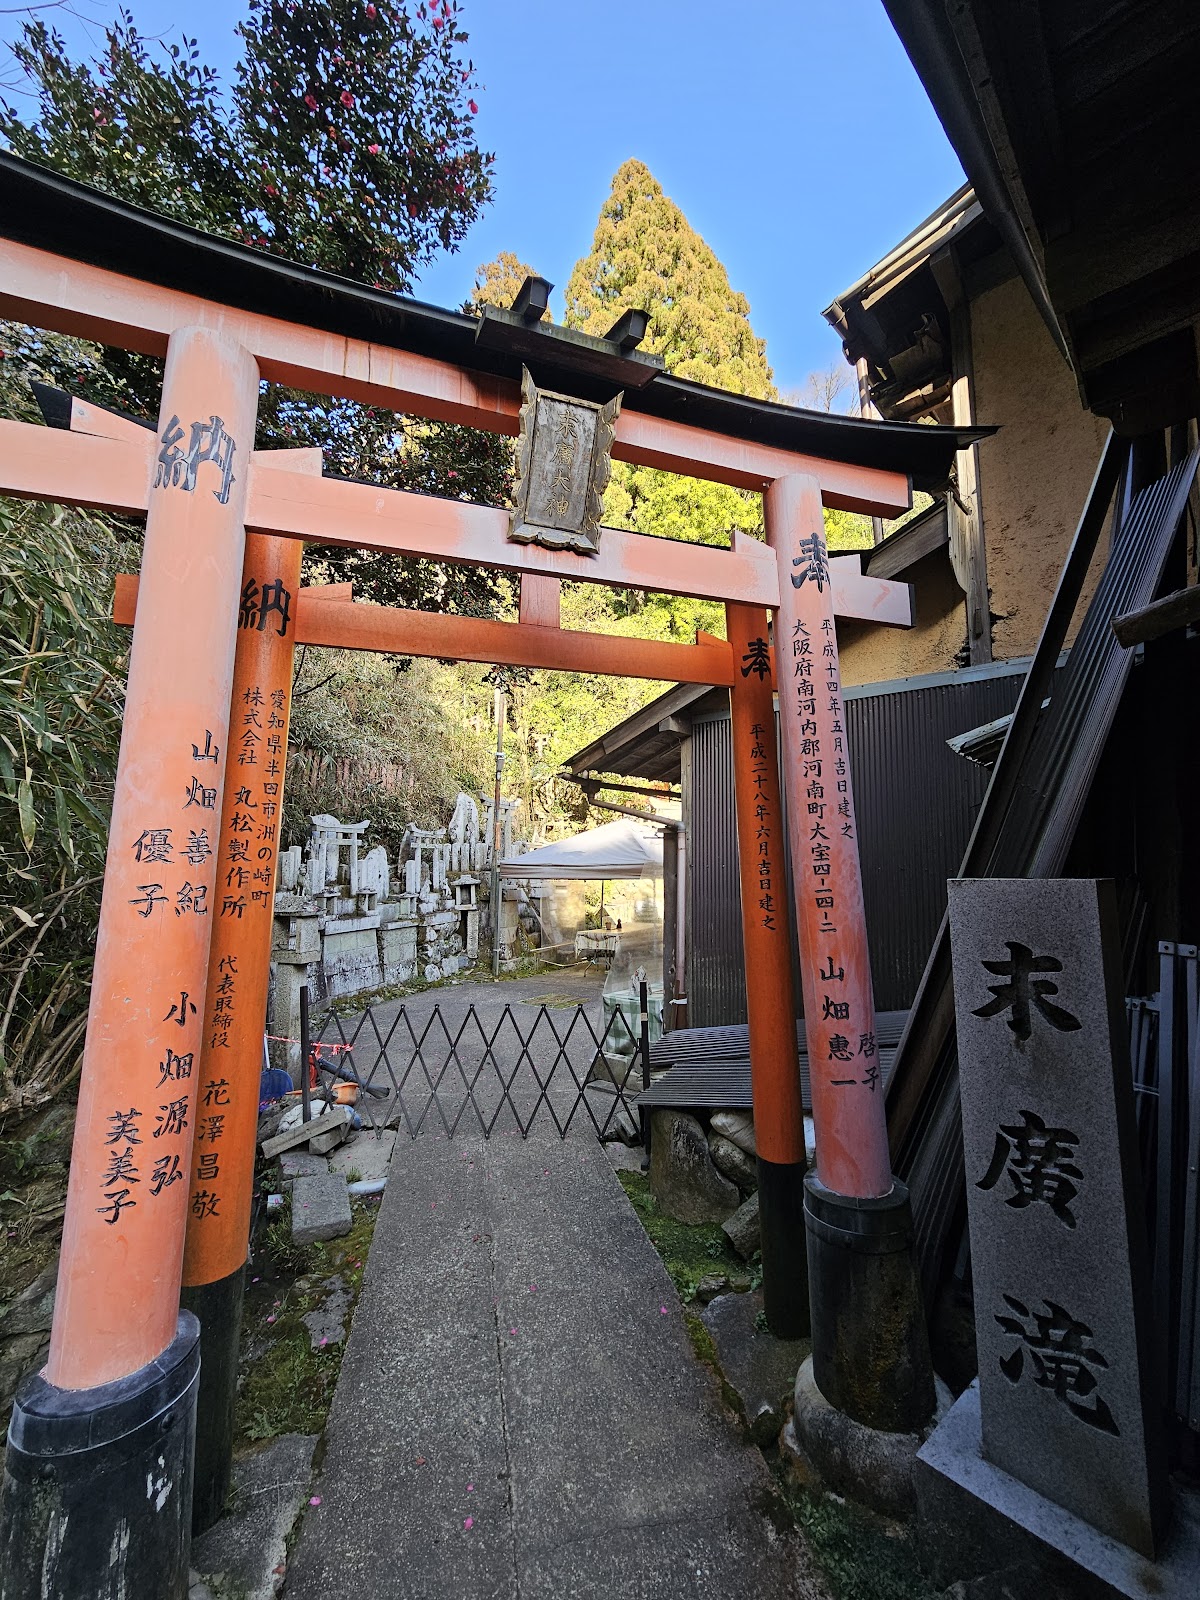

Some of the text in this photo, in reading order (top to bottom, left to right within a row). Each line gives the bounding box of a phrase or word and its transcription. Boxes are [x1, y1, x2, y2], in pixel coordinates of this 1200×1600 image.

[152, 414, 236, 504] 納
[237, 578, 291, 637] 納
[790, 532, 830, 593] 奉
[740, 637, 772, 682] 奉
[820, 619, 854, 840] 平成十四年五月吉日建之
[250, 689, 287, 909] 愛知県半田市洲の崎町
[749, 723, 776, 931] 平成二十八年六月吉日建之
[128, 828, 176, 918] 優子
[191, 687, 266, 1220] 株式会社 丸松製作所 代表取締役 花澤昌敬
[149, 992, 198, 1196] 小畑源弘
[858, 1031, 880, 1093] 啓子
[95, 1107, 144, 1225] 芙美子
[971, 941, 1121, 1437] 末廣滝
